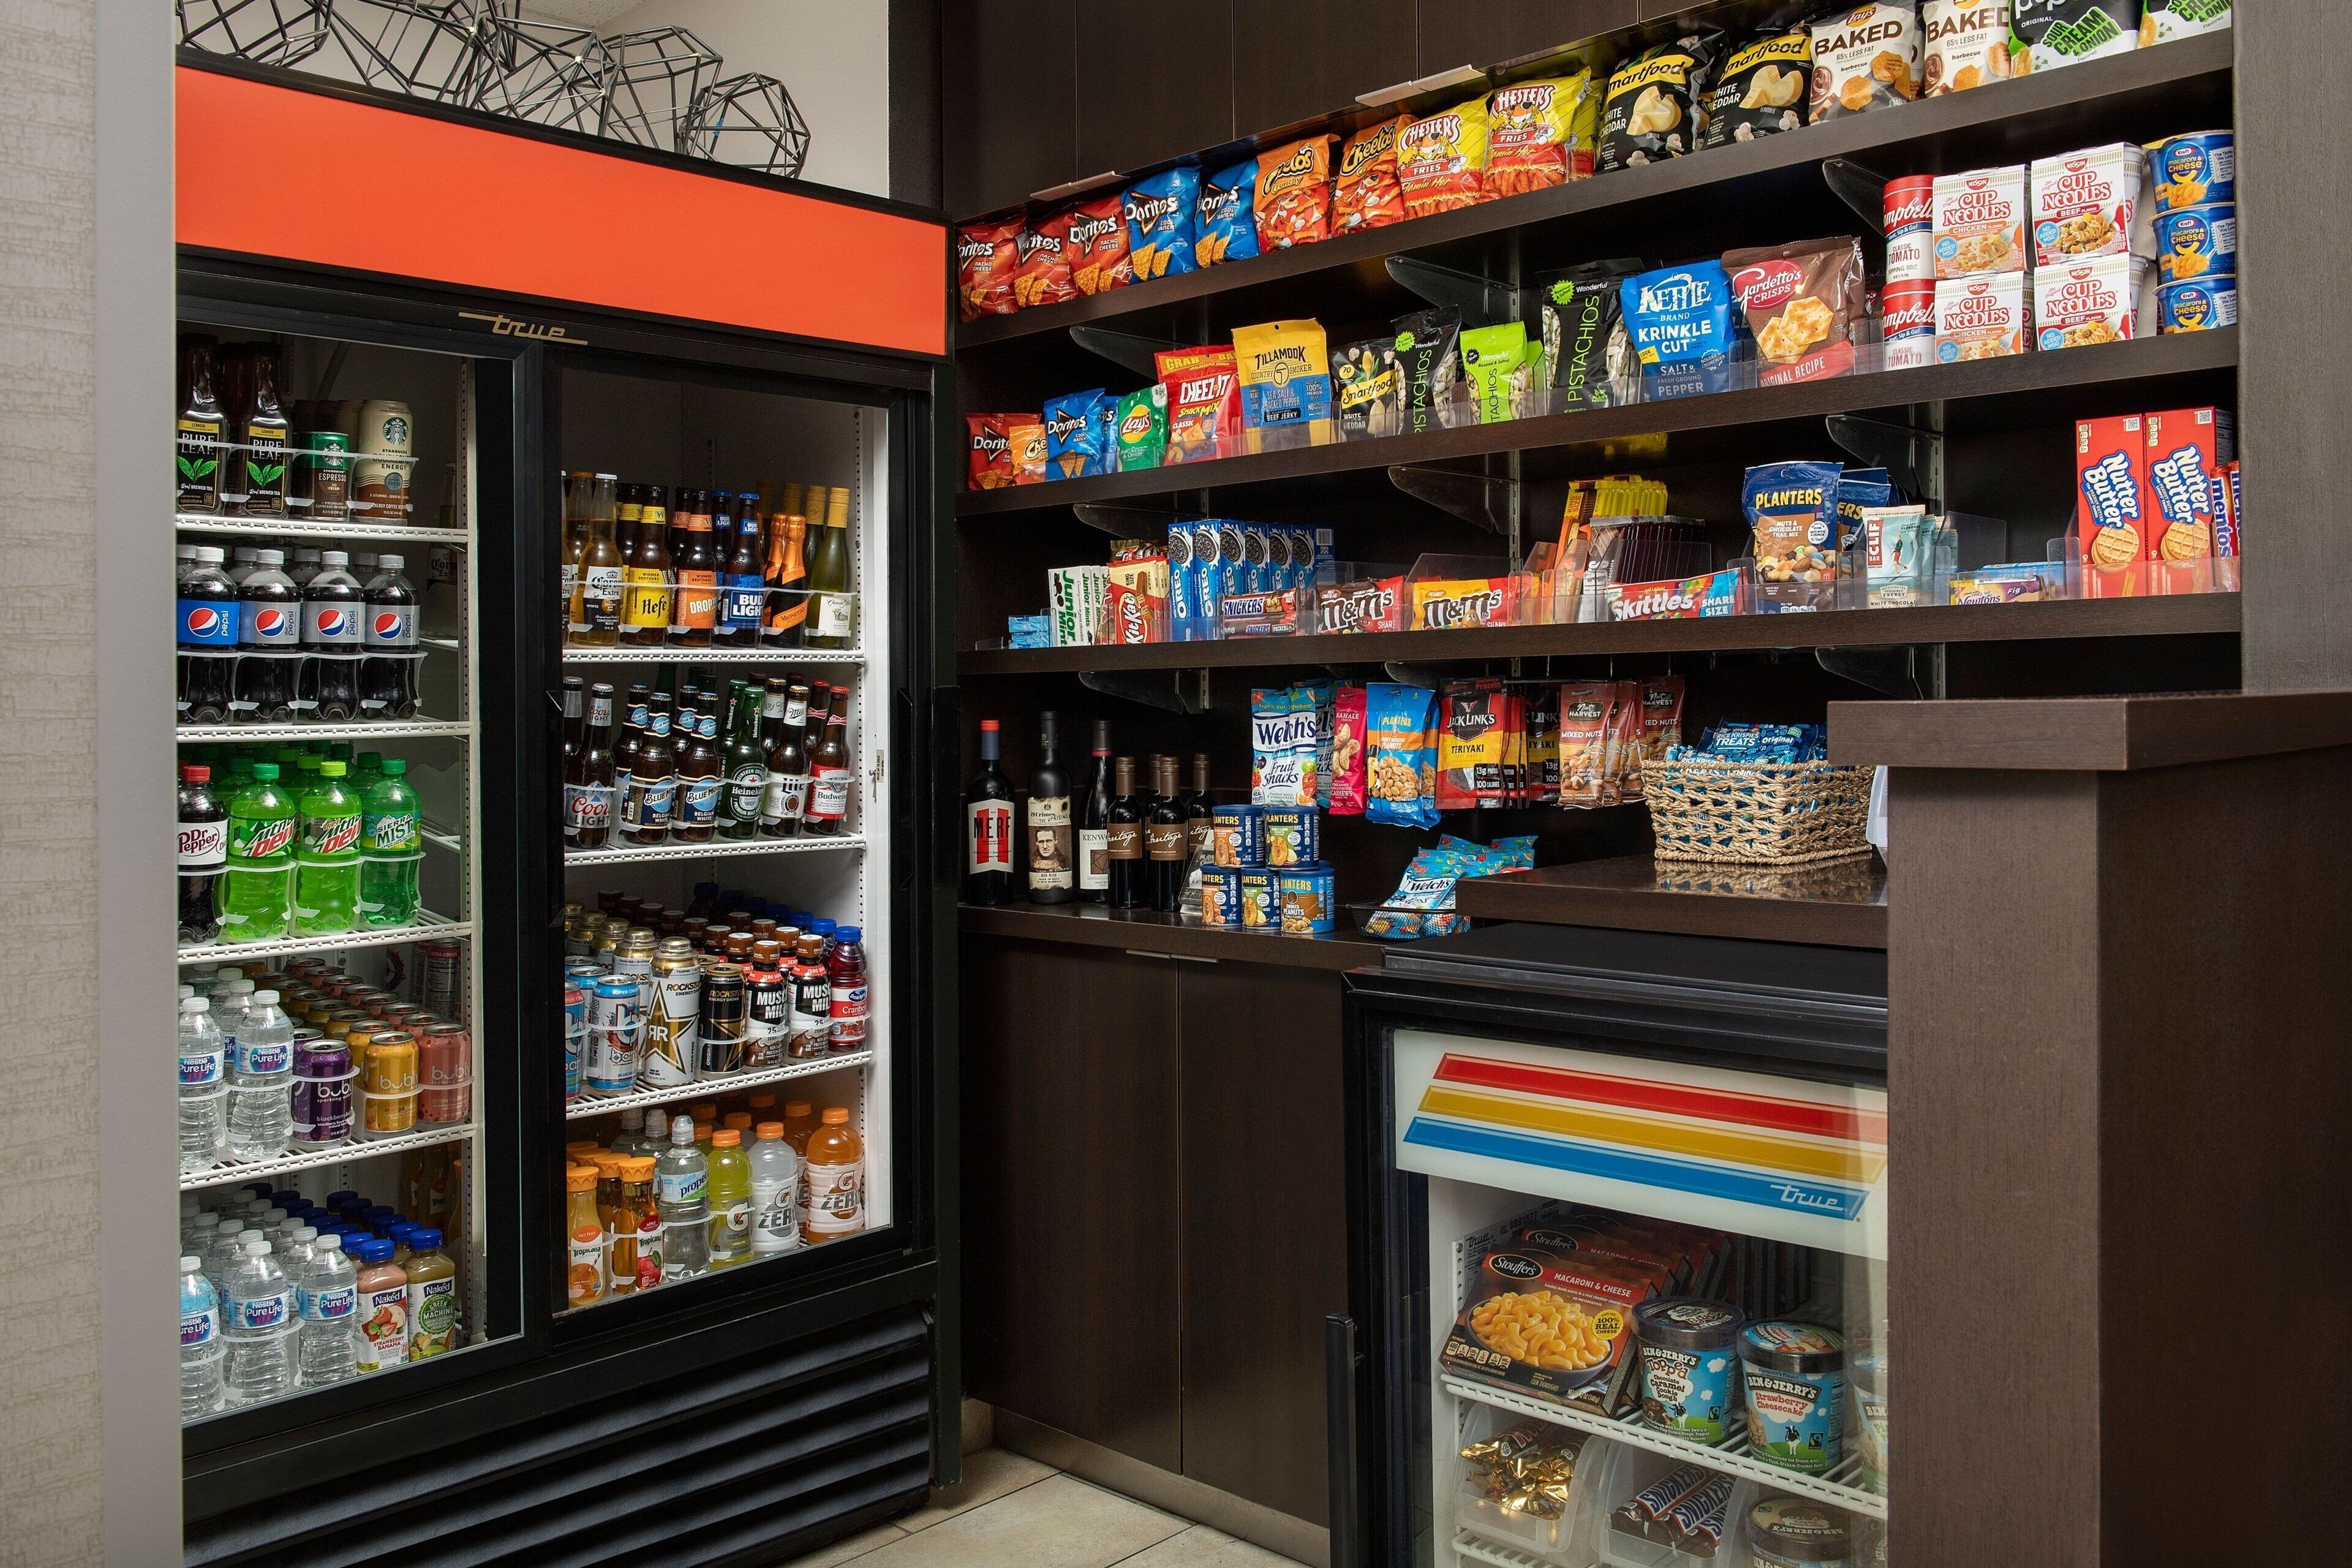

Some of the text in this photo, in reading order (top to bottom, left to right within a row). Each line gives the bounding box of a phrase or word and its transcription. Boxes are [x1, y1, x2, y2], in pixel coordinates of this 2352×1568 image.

[1848, 9, 1875, 23] Lay's
[2021, 16, 2053, 28] ORIGINAL
[1927, 6, 2009, 44] BAKED
[2053, 9, 2108, 56] CREAM
[1815, 20, 1902, 56] BAKED
[1959, 35, 1975, 45] LESS
[1976, 32, 1988, 42] FAT
[2042, 21, 2069, 48] SOUR
[1951, 50, 1981, 60] barbecue
[2077, 50, 2097, 62] Flavored
[1841, 61, 1868, 72] barbecue
[1500, 133, 1528, 143] FRIES
[1341, 124, 1396, 176] Cheetos
[1414, 164, 1441, 175] FRIES
[1271, 176, 1303, 194] Crunchy
[2057, 171, 2097, 190] CUP
[1959, 190, 1997, 209] CUP
[2042, 183, 2111, 212] NOODLES
[1126, 196, 1178, 221] Doritos
[1943, 202, 2010, 227] NOODLES
[2060, 208, 2081, 217] BEEF
[1217, 212, 1235, 221] RANCH
[1070, 216, 1117, 243] Doritos
[1953, 224, 1987, 235] CHICKEN
[1888, 249, 1920, 265] TOMATO
[1576, 282, 1608, 293] Wonderful
[1635, 273, 1713, 314] KETTLE
[1754, 285, 1791, 304] CRISPS
[2062, 280, 2101, 298] CUP
[1959, 296, 1997, 314] CUP
[2046, 292, 2117, 318] NOODLES
[1660, 312, 1691, 322] BRAND
[1944, 307, 2010, 331] NOODLES
[1638, 320, 1713, 342] KRINKLE
[1415, 339, 1440, 349] Wonderful
[1567, 295, 1600, 402] PISTACHIOS
[1165, 357, 1200, 371] GRAB
[1254, 346, 1306, 370] TILLAMOOK
[1888, 353, 1922, 368] TOMATO
[1251, 364, 1313, 380] COUNTRY SMOKER
[1343, 375, 1394, 405] Smartfood
[1658, 382, 1704, 397] PEPPER
[1048, 415, 1086, 435] Doritos
[1122, 413, 1150, 434] Lay's
[1172, 420, 1194, 429] CLASSIC
[318, 473, 347, 483] ESPRESSO
[2173, 445, 2211, 514] Nutter
[2102, 452, 2139, 520] Nutter
[2154, 459, 2194, 524] Butter
[1755, 489, 1823, 510] PLANTERS
[2084, 466, 2124, 529] Butter
[2211, 478, 2233, 558] mentos
[1868, 522, 1882, 556] CLIF
[1174, 569, 1188, 619] OREO
[1201, 567, 1214, 618] OREO
[2007, 586, 2021, 596] Fig
[642, 595, 668, 619] Hefe
[739, 594, 763, 605] BUD
[1063, 569, 1076, 642] Junior
[1224, 598, 1264, 616] SNICKERS
[1611, 592, 1695, 620] Skittles
[1702, 595, 1735, 608] SHARE
[780, 607, 805, 622] MIONETTO
[1705, 607, 1729, 617] SIZE
[1246, 624, 1270, 634] SNICKERS
[1378, 620, 1396, 630] SHARE
[589, 703, 611, 717] Coors
[1382, 717, 1411, 727] PLANTERS
[1447, 712, 1495, 728] JACK LINK'S
[1585, 729, 1602, 738] NUTS
[1762, 736, 1795, 745] Original
[1450, 744, 1485, 754] TERIYAKI
[1716, 737, 1755, 747] TREATS
[1271, 760, 1295, 776] Fruit
[781, 777, 805, 794] Lite
[1262, 771, 1298, 787] Snacks
[644, 791, 665, 806] BLUE
[687, 790, 707, 804] BLUE
[323, 818, 339, 831] diet
[377, 814, 412, 832] SIERRA
[575, 815, 610, 826] LIGHT
[973, 816, 1011, 839] MERF
[190, 829, 208, 840] Dr
[178, 832, 217, 854] Pepper
[1409, 879, 1451, 892] Welch's
[252, 1052, 288, 1064] Pure Life
[432, 1065, 470, 1080] bubly
[380, 1071, 418, 1090] bubly
[680, 1170, 707, 1198] propel
[639, 1235, 662, 1248] Tropicana
[1532, 1233, 1573, 1250] Stouffer's
[573, 1246, 601, 1257] Tropicana
[1494, 1257, 1537, 1276] Stouffer's
[426, 1281, 450, 1295] Naked
[1555, 1273, 1632, 1298] MACARONI & CHEESE
[321, 1295, 355, 1308] Pure Life
[375, 1292, 400, 1305] Naked
[429, 1300, 448, 1311] GREEN
[246, 1305, 282, 1317] Pure Life
[423, 1307, 454, 1320] MACHINE
[374, 1336, 405, 1347] STRAWBERRY
[377, 1341, 401, 1351] BANANA
[1646, 1358, 1689, 1379] Topped
[1650, 1379, 1685, 1393] Caramel
[1653, 1374, 1680, 1385] Chocolate
[1656, 1386, 1678, 1396] Cookie
[1657, 1392, 1678, 1403] Dough
[1755, 1392, 1809, 1411] Strawberry
[1756, 1400, 1804, 1417] Cheesecake
